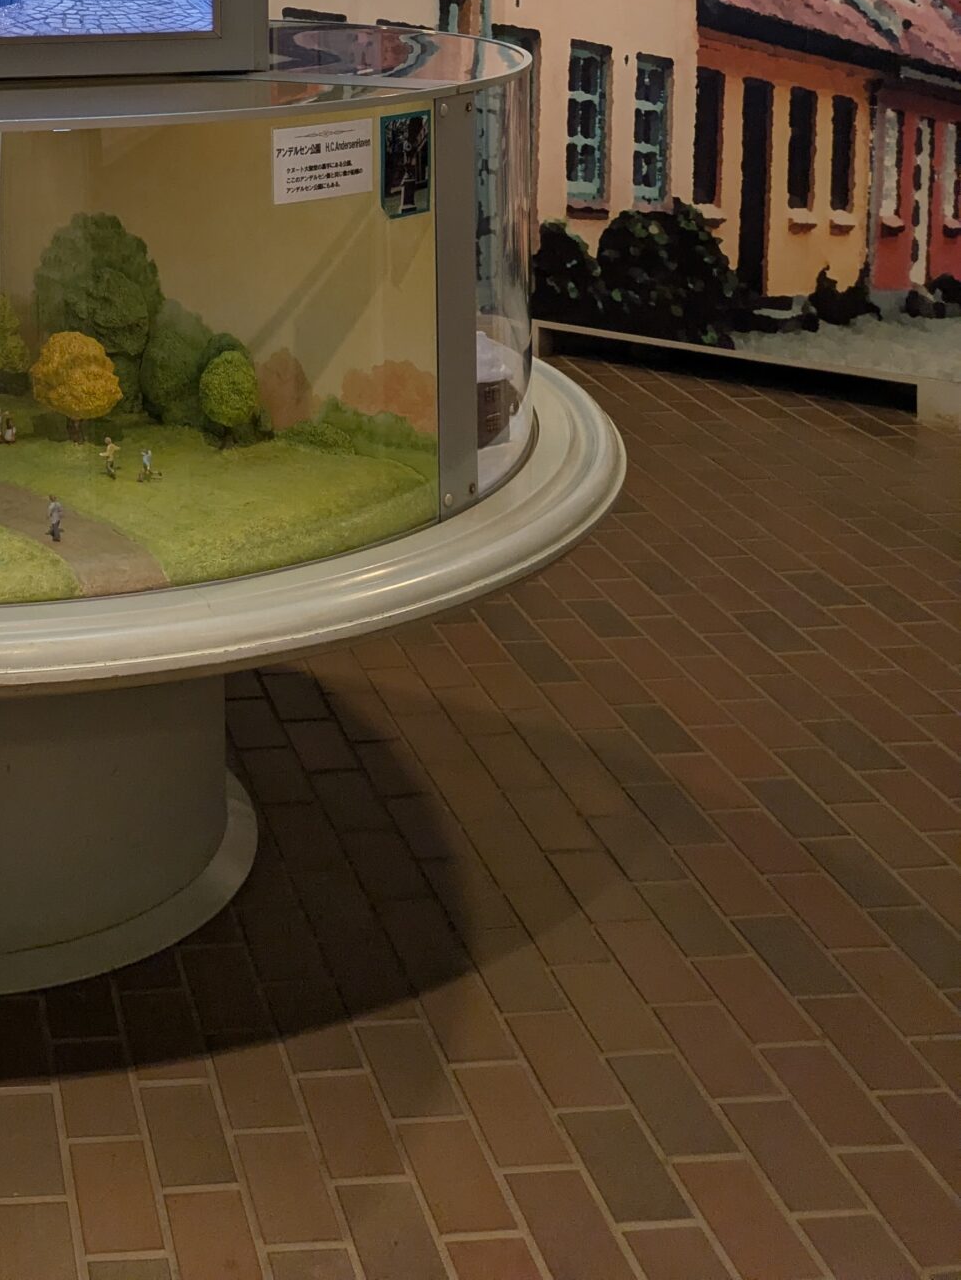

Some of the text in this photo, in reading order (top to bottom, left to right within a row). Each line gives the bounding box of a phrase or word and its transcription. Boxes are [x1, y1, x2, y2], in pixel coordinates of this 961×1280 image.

[275, 143, 322, 158] アンデルセン公園
